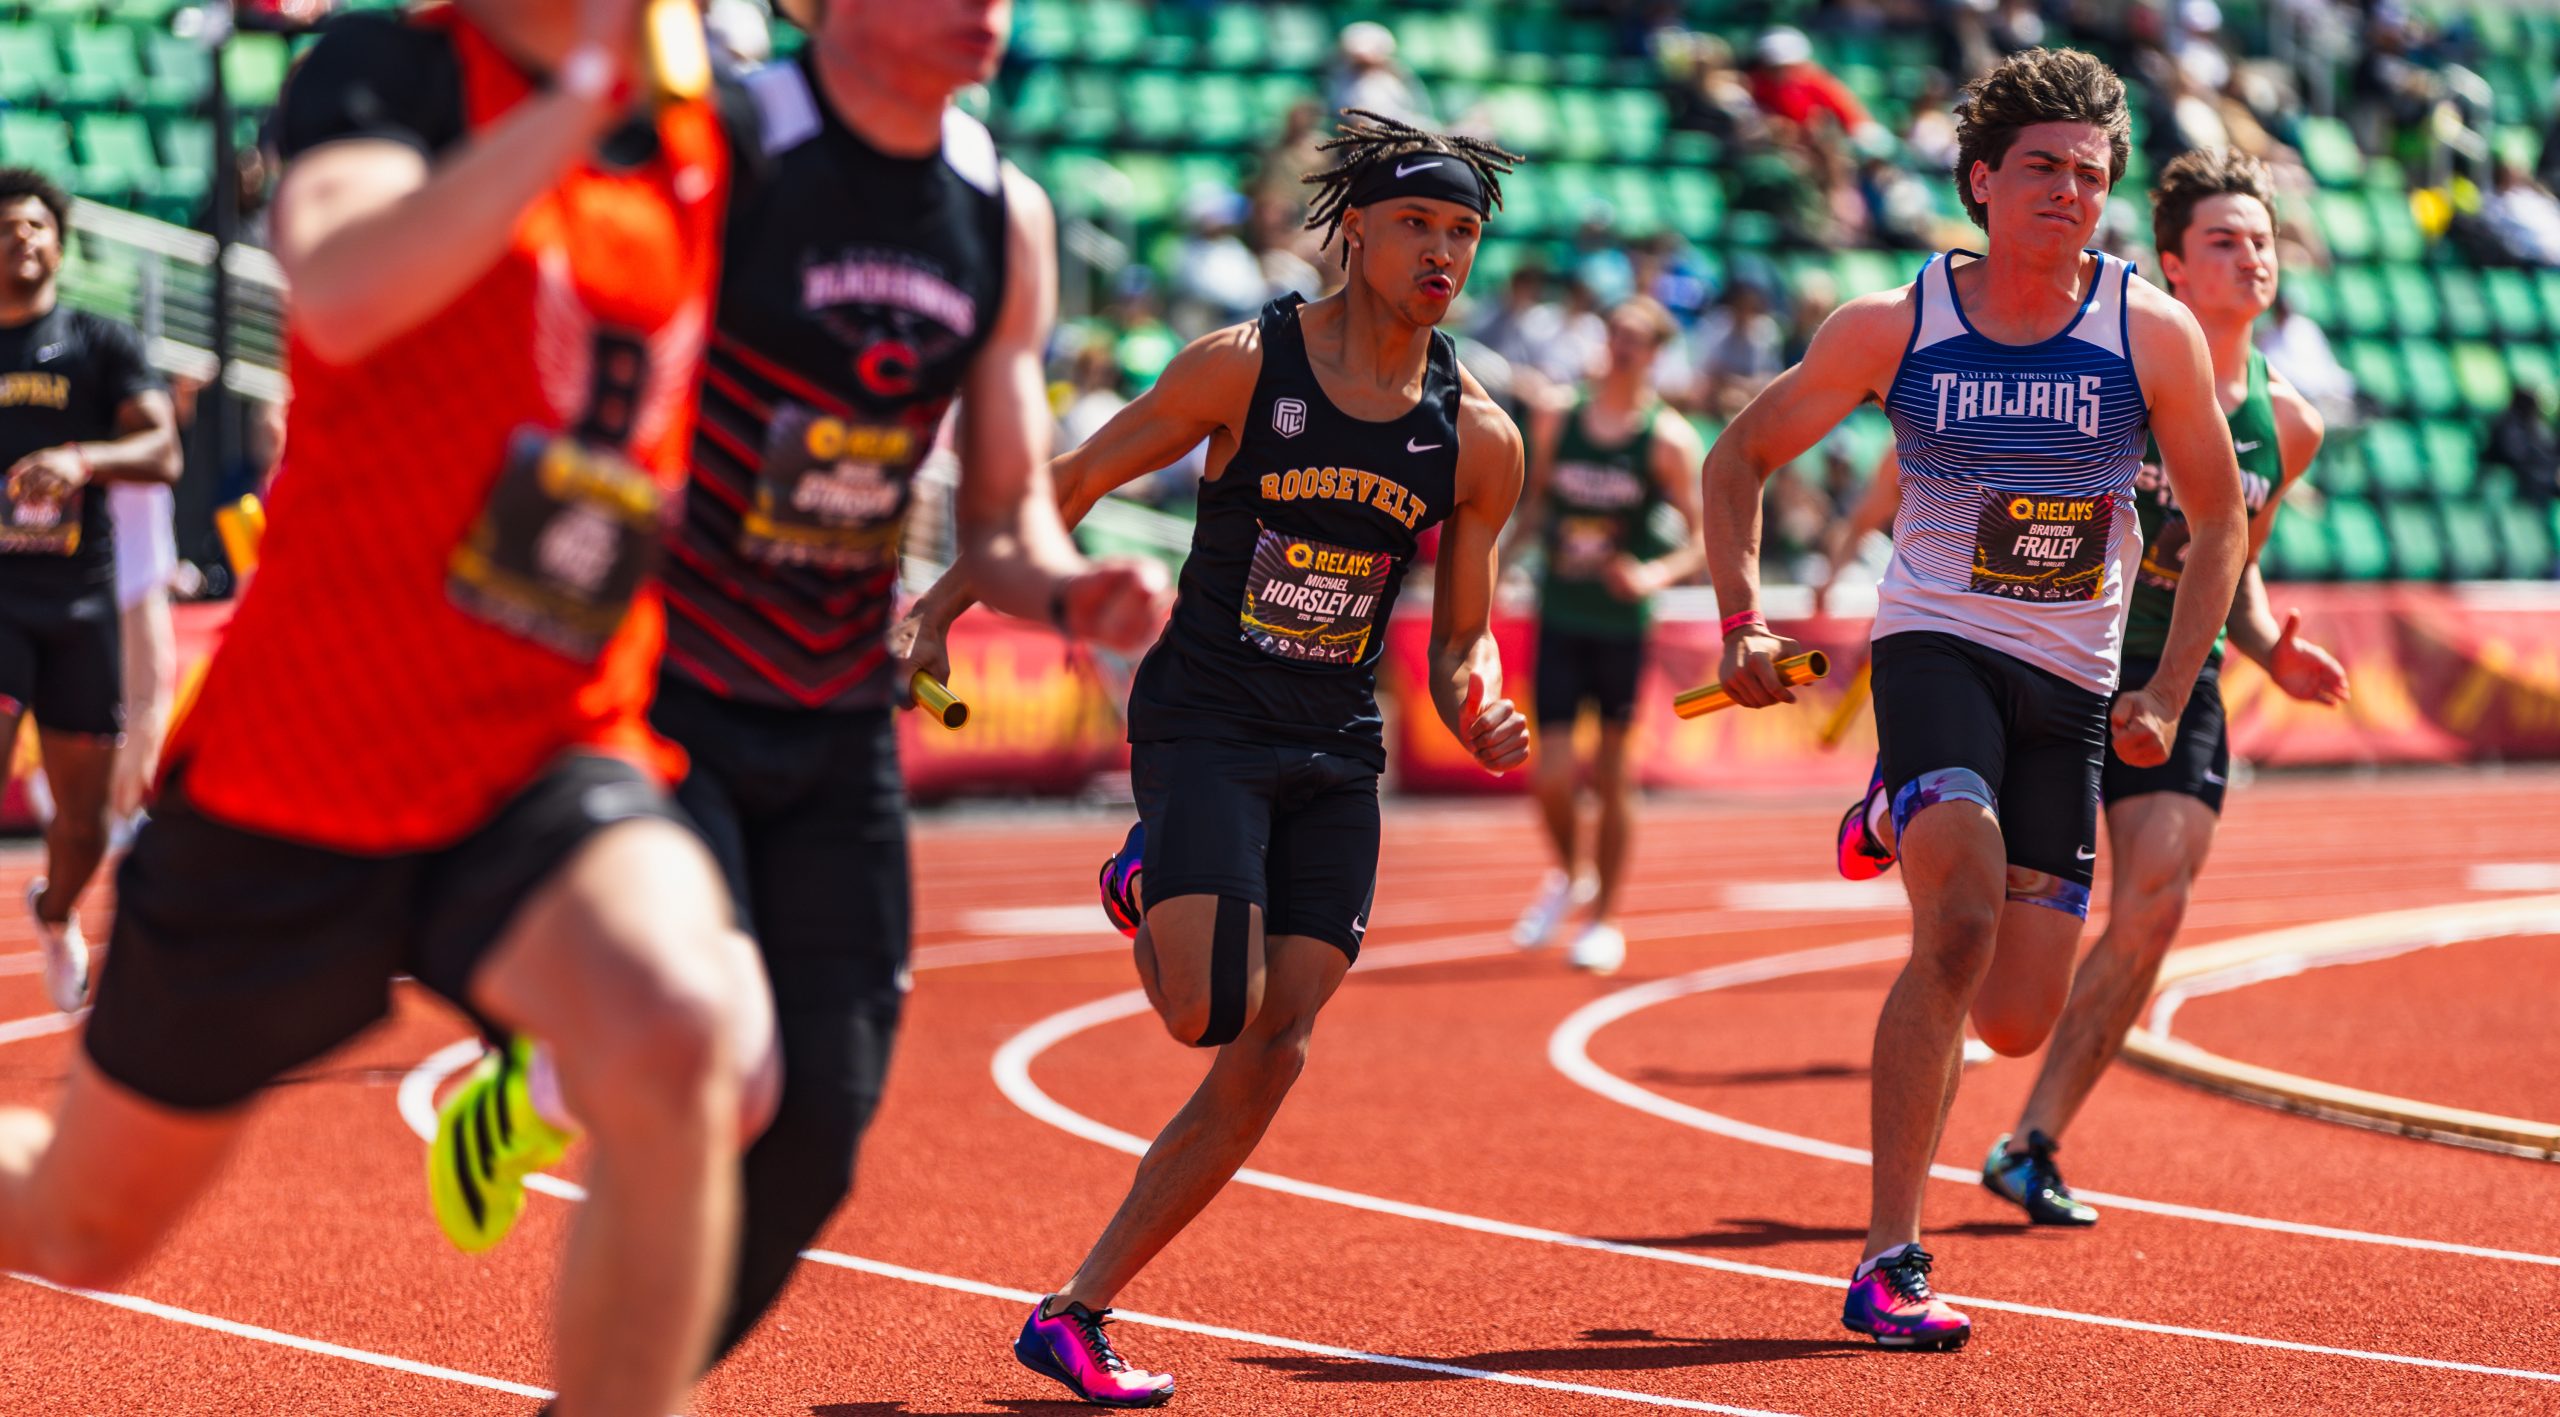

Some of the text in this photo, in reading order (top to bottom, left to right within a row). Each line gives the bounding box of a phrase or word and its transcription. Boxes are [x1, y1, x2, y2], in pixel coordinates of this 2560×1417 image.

[1960, 372, 2073, 381] VALLEY CHRISTIAN
[1932, 373, 2101, 439] TROJANS
[1260, 466, 1427, 530] ROOSEVELT
[2036, 502, 2094, 521] RELAYS
[2028, 523, 2075, 537] BRAYDEN
[2011, 535, 2083, 559] FRALEY
[1314, 550, 1373, 577] RELAYS
[1304, 573, 1349, 592] MICHAEL
[1260, 579, 1374, 618] HORSLEY III
